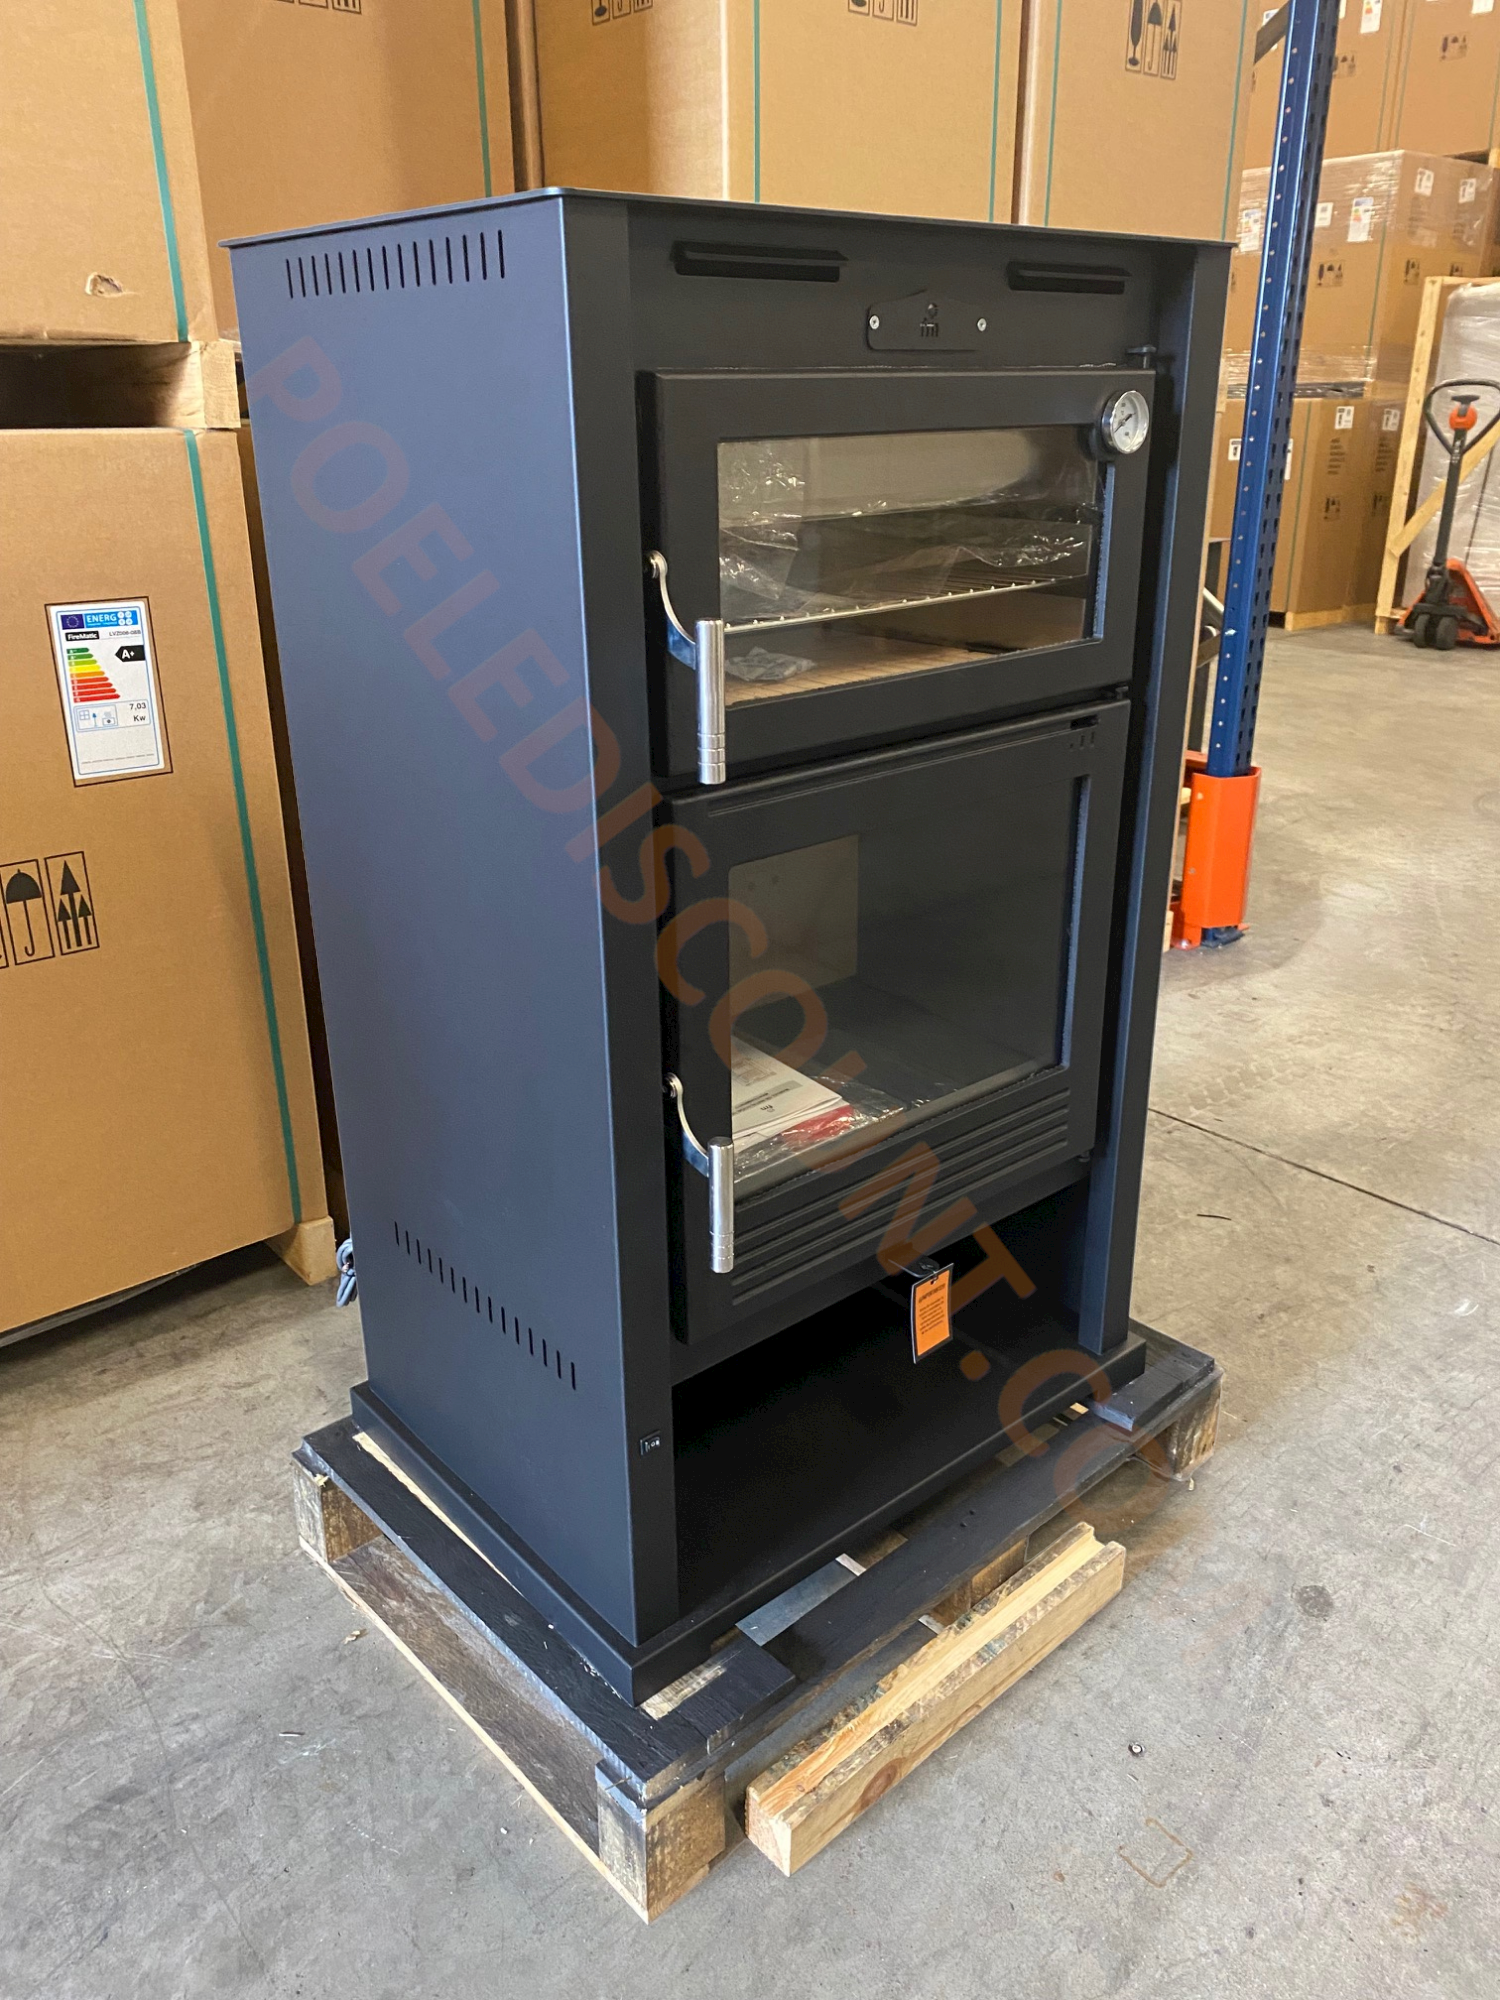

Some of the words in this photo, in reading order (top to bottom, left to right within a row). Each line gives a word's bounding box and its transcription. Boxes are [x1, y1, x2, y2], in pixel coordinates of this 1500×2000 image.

[86, 613, 117, 623] ENERG
[121, 649, 135, 660] A+
[129, 702, 147, 711] 7,03
